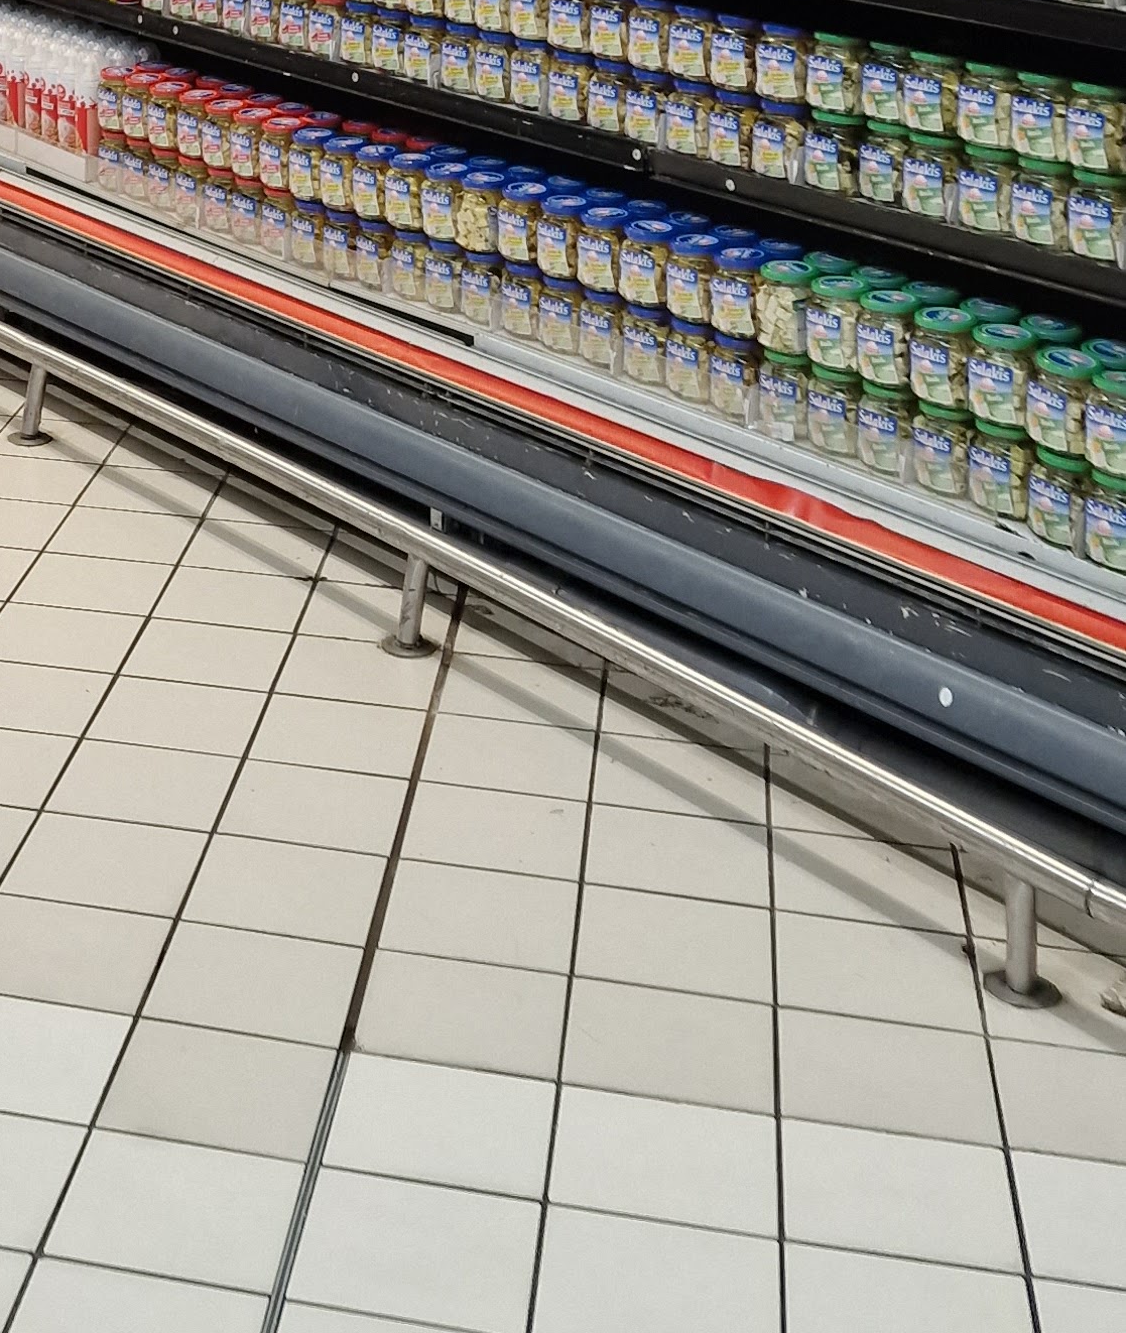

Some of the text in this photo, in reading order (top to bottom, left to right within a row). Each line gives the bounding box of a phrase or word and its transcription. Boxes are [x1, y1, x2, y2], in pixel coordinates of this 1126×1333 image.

[281, 4, 303, 17] Salakis
[550, 0, 579, 14] Salakis
[591, 8, 619, 21] Salakis
[310, 11, 332, 24] Salakis
[629, 18, 657, 31] Salakis
[342, 20, 363, 32] Salakis
[671, 28, 701, 41] Salakis
[442, 44, 467, 57] Salakis
[714, 37, 743, 50] Salakis
[477, 53, 503, 65] Salakis
[759, 46, 792, 61] Salakis
[809, 57, 840, 70] Salakis
[550, 74, 576, 86] Salakis
[864, 66, 895, 81] Salakis
[589, 83, 615, 96] Salakis
[906, 76, 939, 93] Salakis
[627, 93, 653, 106] Salakis
[959, 87, 993, 104] Salakis
[665, 104, 693, 117] Salakis
[1013, 97, 1049, 116] Salakis
[710, 115, 737, 130] Salakis
[1067, 110, 1102, 127] Salakis
[754, 125, 781, 140] Salakis
[806, 135, 836, 152] Salakis
[861, 145, 890, 163] Salakis
[905, 160, 940, 177] Salakis
[353, 170, 374, 183] Salakis
[960, 172, 995, 191] Salakis
[386, 179, 407, 193] Salakis
[422, 190, 449, 204] Salakis
[1013, 186, 1048, 204] Salakis
[1069, 199, 1108, 217] Salakis
[500, 210, 524, 225] Salakis
[538, 224, 564, 239] Salakis
[578, 237, 609, 252] Salakis
[622, 252, 652, 267] Salakis
[425, 261, 449, 275] Salakis
[667, 264, 695, 281] Salakis
[462, 271, 487, 286] Salakis
[502, 286, 527, 300] Salakis
[712, 282, 747, 297] Salakis
[540, 298, 568, 315] Salakis
[581, 313, 608, 328] Salakis
[807, 309, 838, 327] Salakis
[624, 328, 654, 345] Salakis
[857, 326, 891, 343] Salakis
[667, 340, 695, 358] Salakis
[911, 342, 946, 363] Salakis
[711, 358, 739, 375] Salakis
[970, 361, 1009, 380] Salakis
[760, 376, 793, 393] Salakis
[809, 393, 842, 412] Salakis
[1028, 384, 1063, 408] Salakis
[859, 411, 894, 431] Salakis
[914, 429, 950, 451] Salakis
[971, 448, 1007, 470] Salakis
[1029, 477, 1068, 503] Salakis
